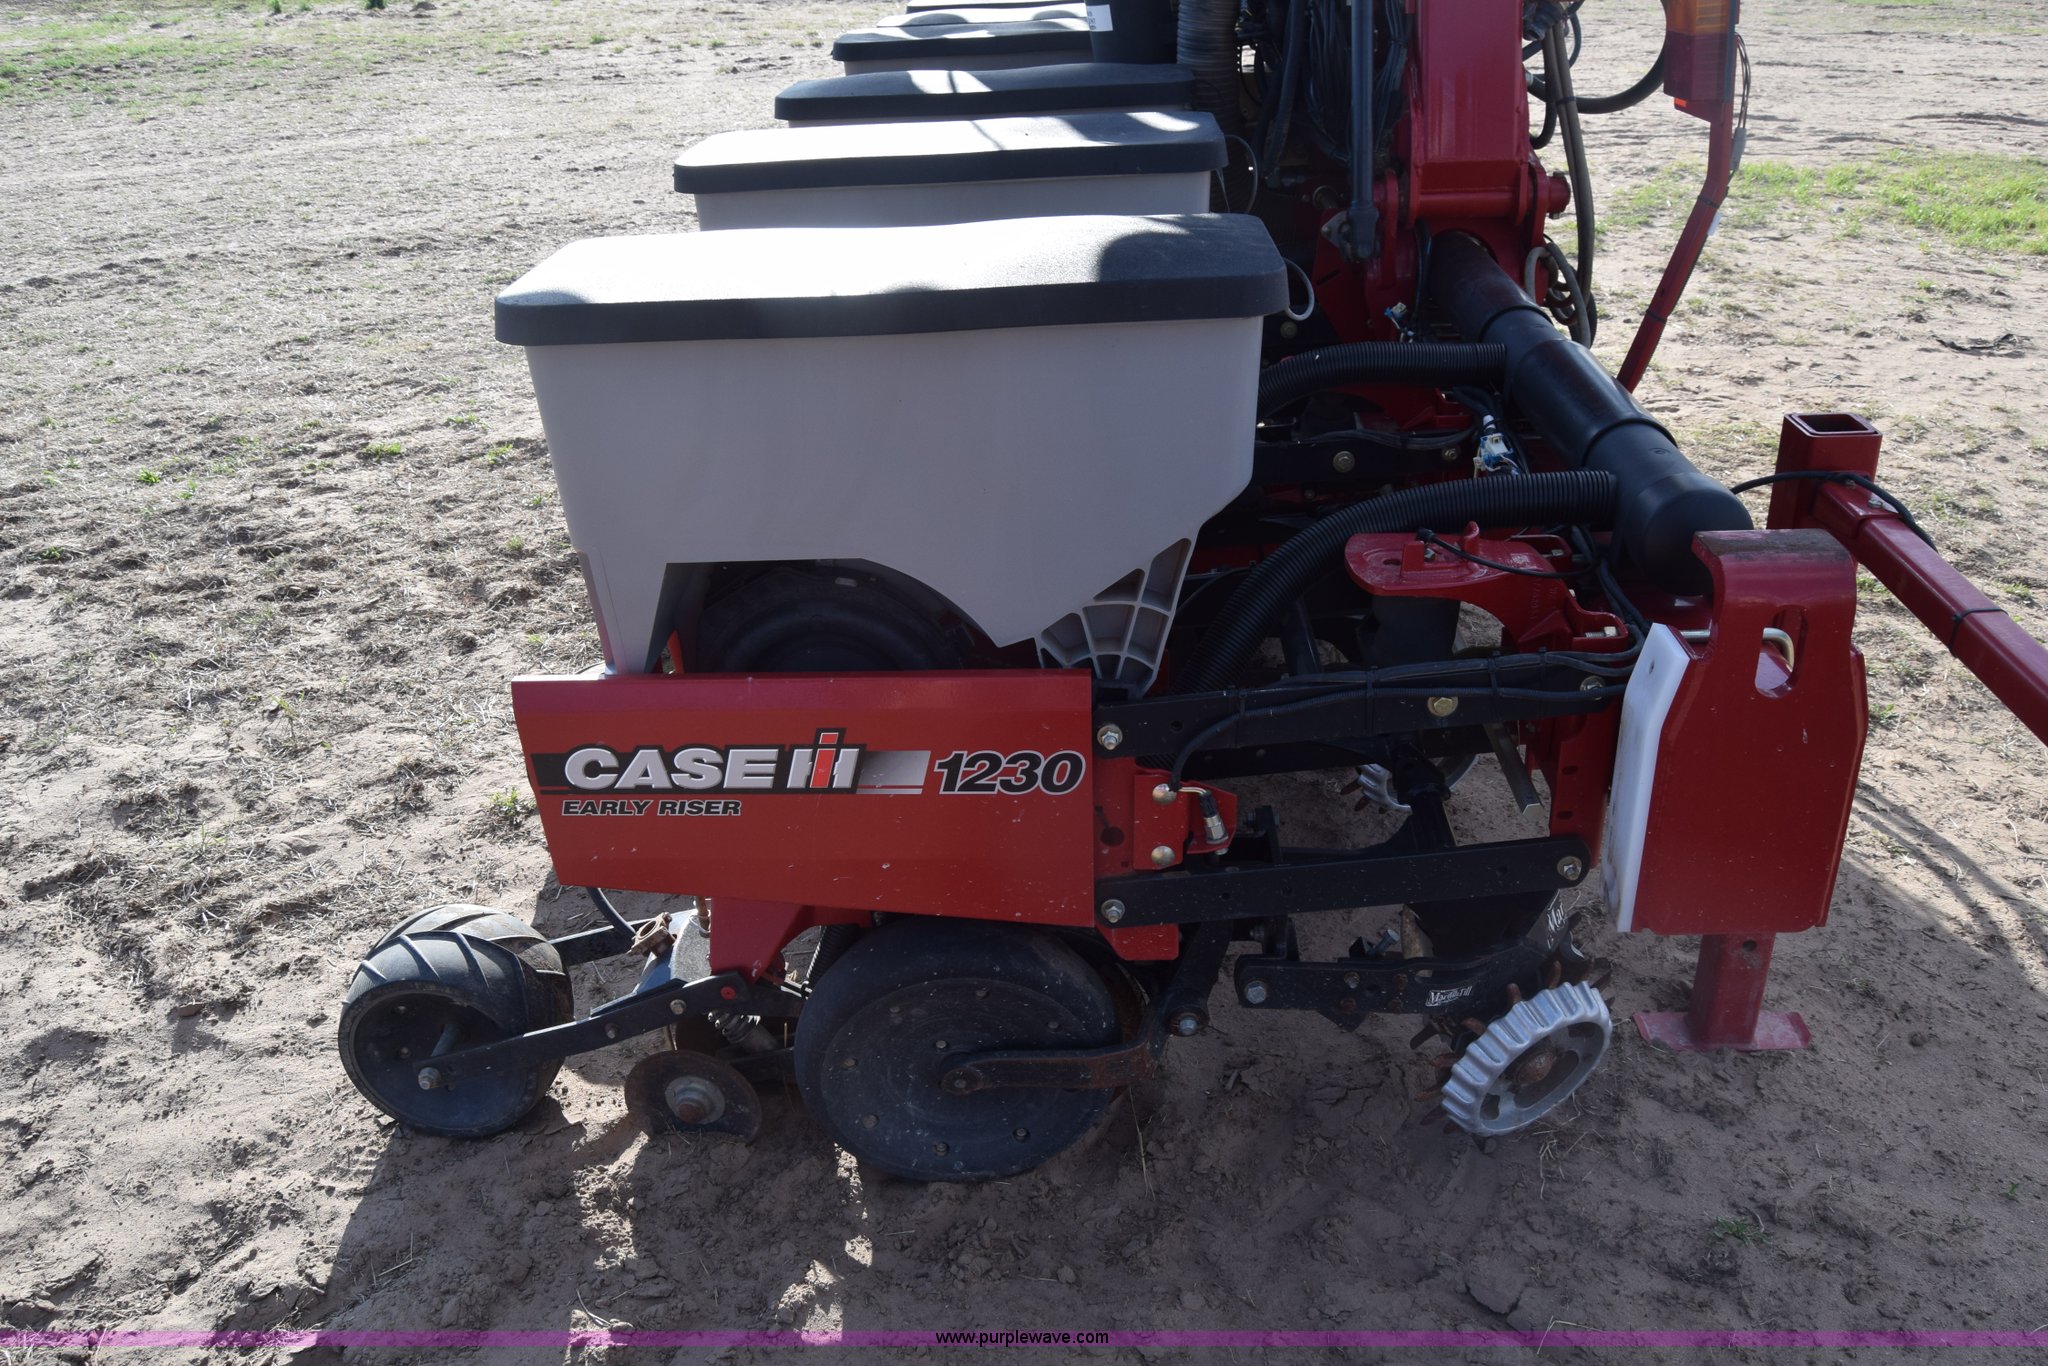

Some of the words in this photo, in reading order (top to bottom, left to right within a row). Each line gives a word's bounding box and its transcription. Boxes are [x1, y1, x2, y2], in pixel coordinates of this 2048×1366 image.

[564, 747, 780, 790] CASE
[934, 749, 1086, 795] 1230
[561, 799, 652, 816] EARLY
[657, 799, 742, 816] RISER
